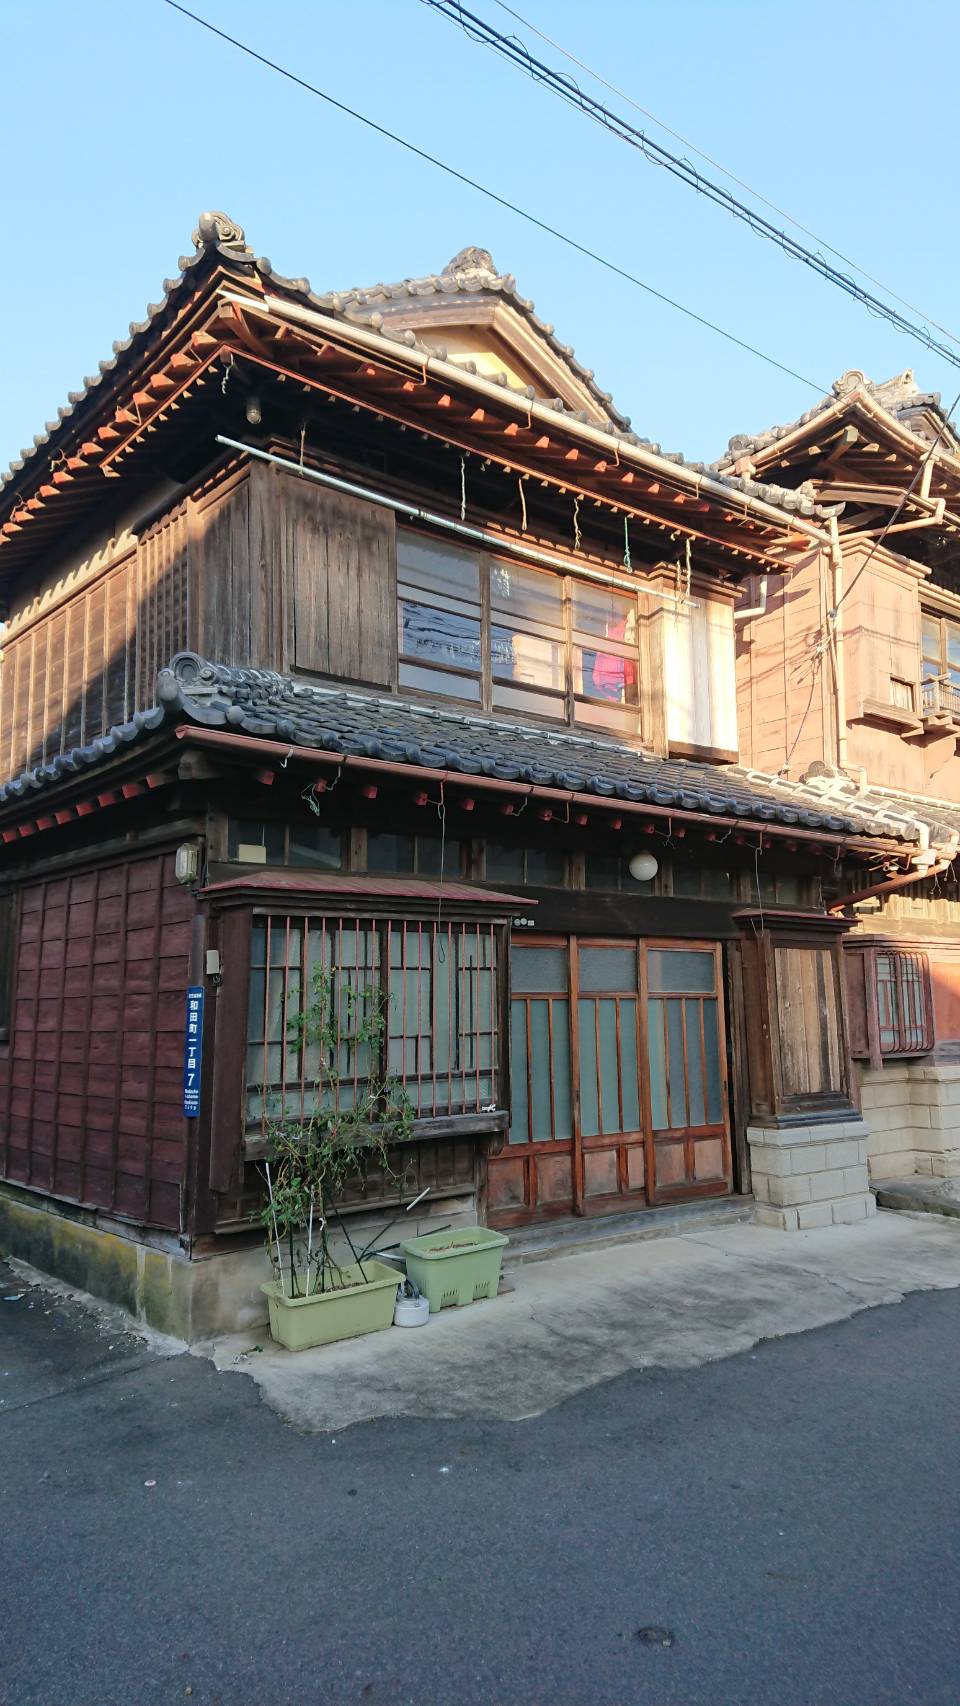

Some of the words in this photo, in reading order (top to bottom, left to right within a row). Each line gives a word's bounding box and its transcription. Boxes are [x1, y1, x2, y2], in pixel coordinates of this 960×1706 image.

[187, 1000, 199, 1069] 和田町一丁目
[187, 1073, 195, 1086] 7
